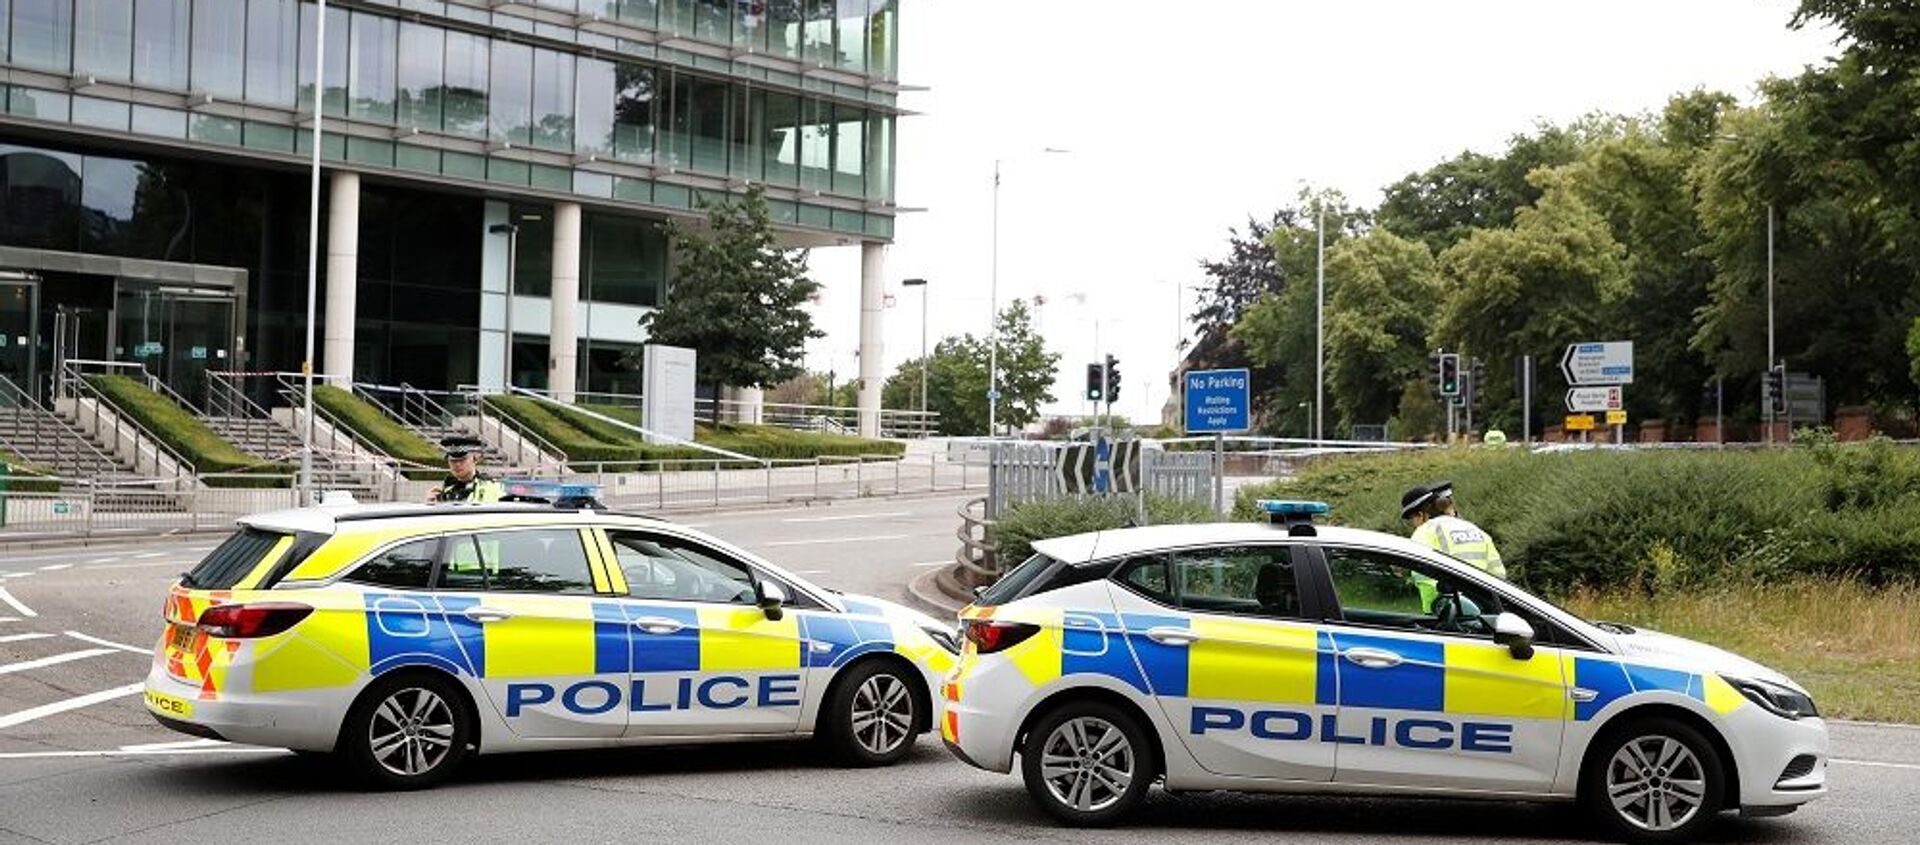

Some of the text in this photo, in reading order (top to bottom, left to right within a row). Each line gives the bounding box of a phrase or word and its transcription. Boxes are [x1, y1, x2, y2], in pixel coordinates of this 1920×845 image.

[1190, 376, 1245, 390] No Parking
[1207, 417, 1227, 425] Apply
[506, 675, 800, 717] POLICE
[1190, 706, 1513, 753] POLICE
